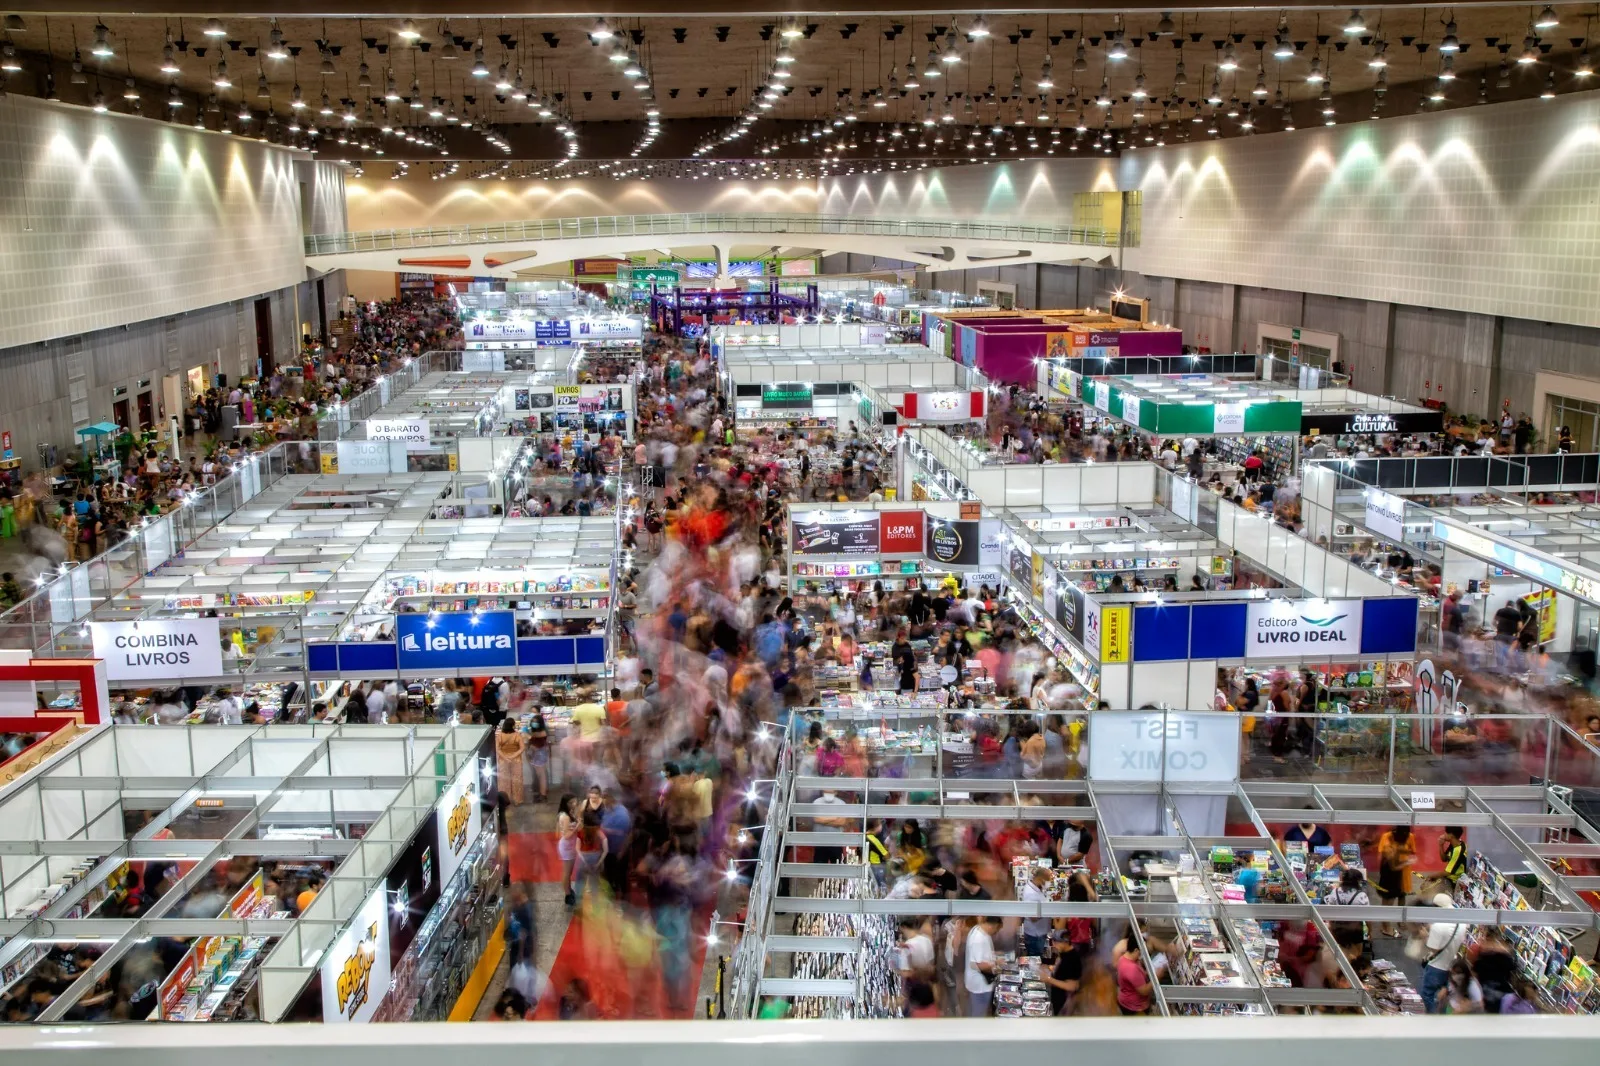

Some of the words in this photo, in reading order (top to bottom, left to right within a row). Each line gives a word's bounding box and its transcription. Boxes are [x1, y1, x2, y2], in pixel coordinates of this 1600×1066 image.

[375, 425, 382, 433] O
[384, 425, 420, 433] BARATO
[1352, 421, 1398, 432] CULTURAL
[887, 526, 914, 535] L&PM
[1258, 617, 1298, 628] Editora
[114, 633, 199, 649] COMBINA
[424, 631, 512, 652] leitura
[1257, 631, 1300, 643] LIVRO
[1304, 630, 1347, 642] IDEAL
[126, 651, 191, 666] LIVROS
[1412, 796, 1434, 804] SAÍDA
